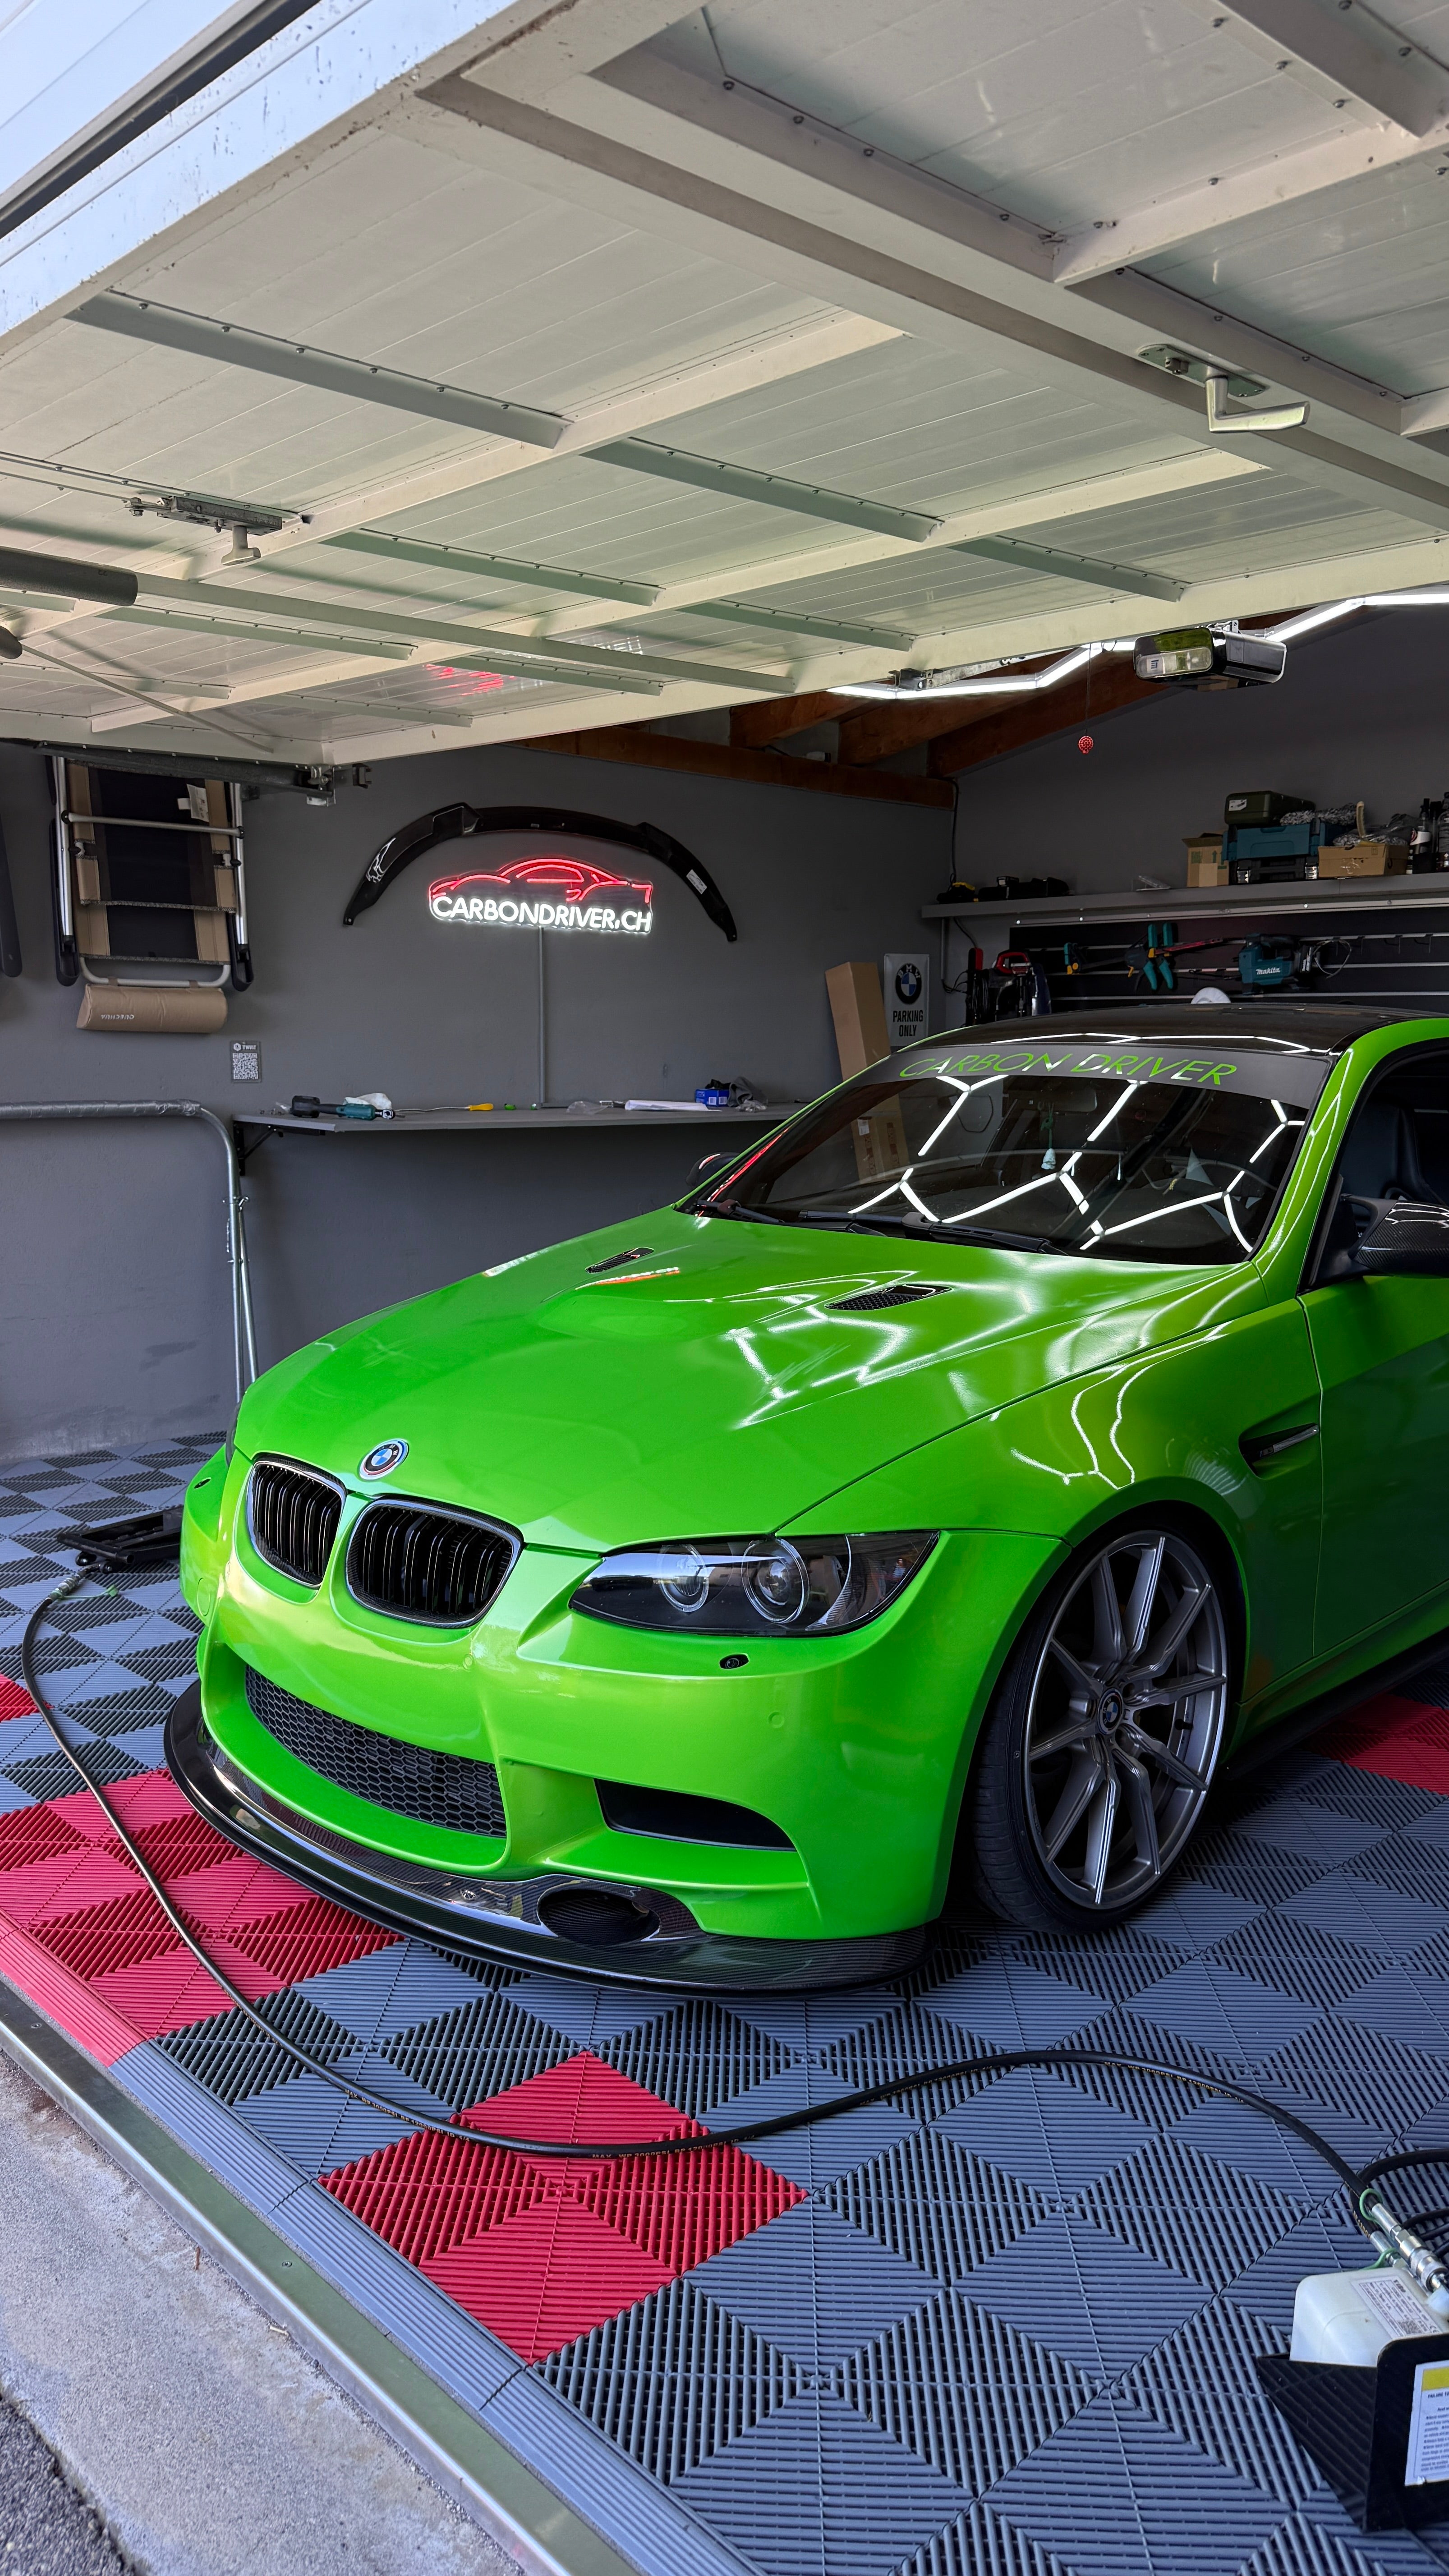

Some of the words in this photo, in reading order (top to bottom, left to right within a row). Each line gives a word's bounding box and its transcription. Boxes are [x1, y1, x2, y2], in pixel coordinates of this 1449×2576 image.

[432, 896, 652, 931] CARBONDRIVER.CH
[897, 965, 920, 978] BMW
[893, 1010, 923, 1022] PARKING
[899, 1025, 917, 1036] ONLY
[899, 1053, 1073, 1077] CARBON
[1071, 1053, 1237, 1085] DRIVER
